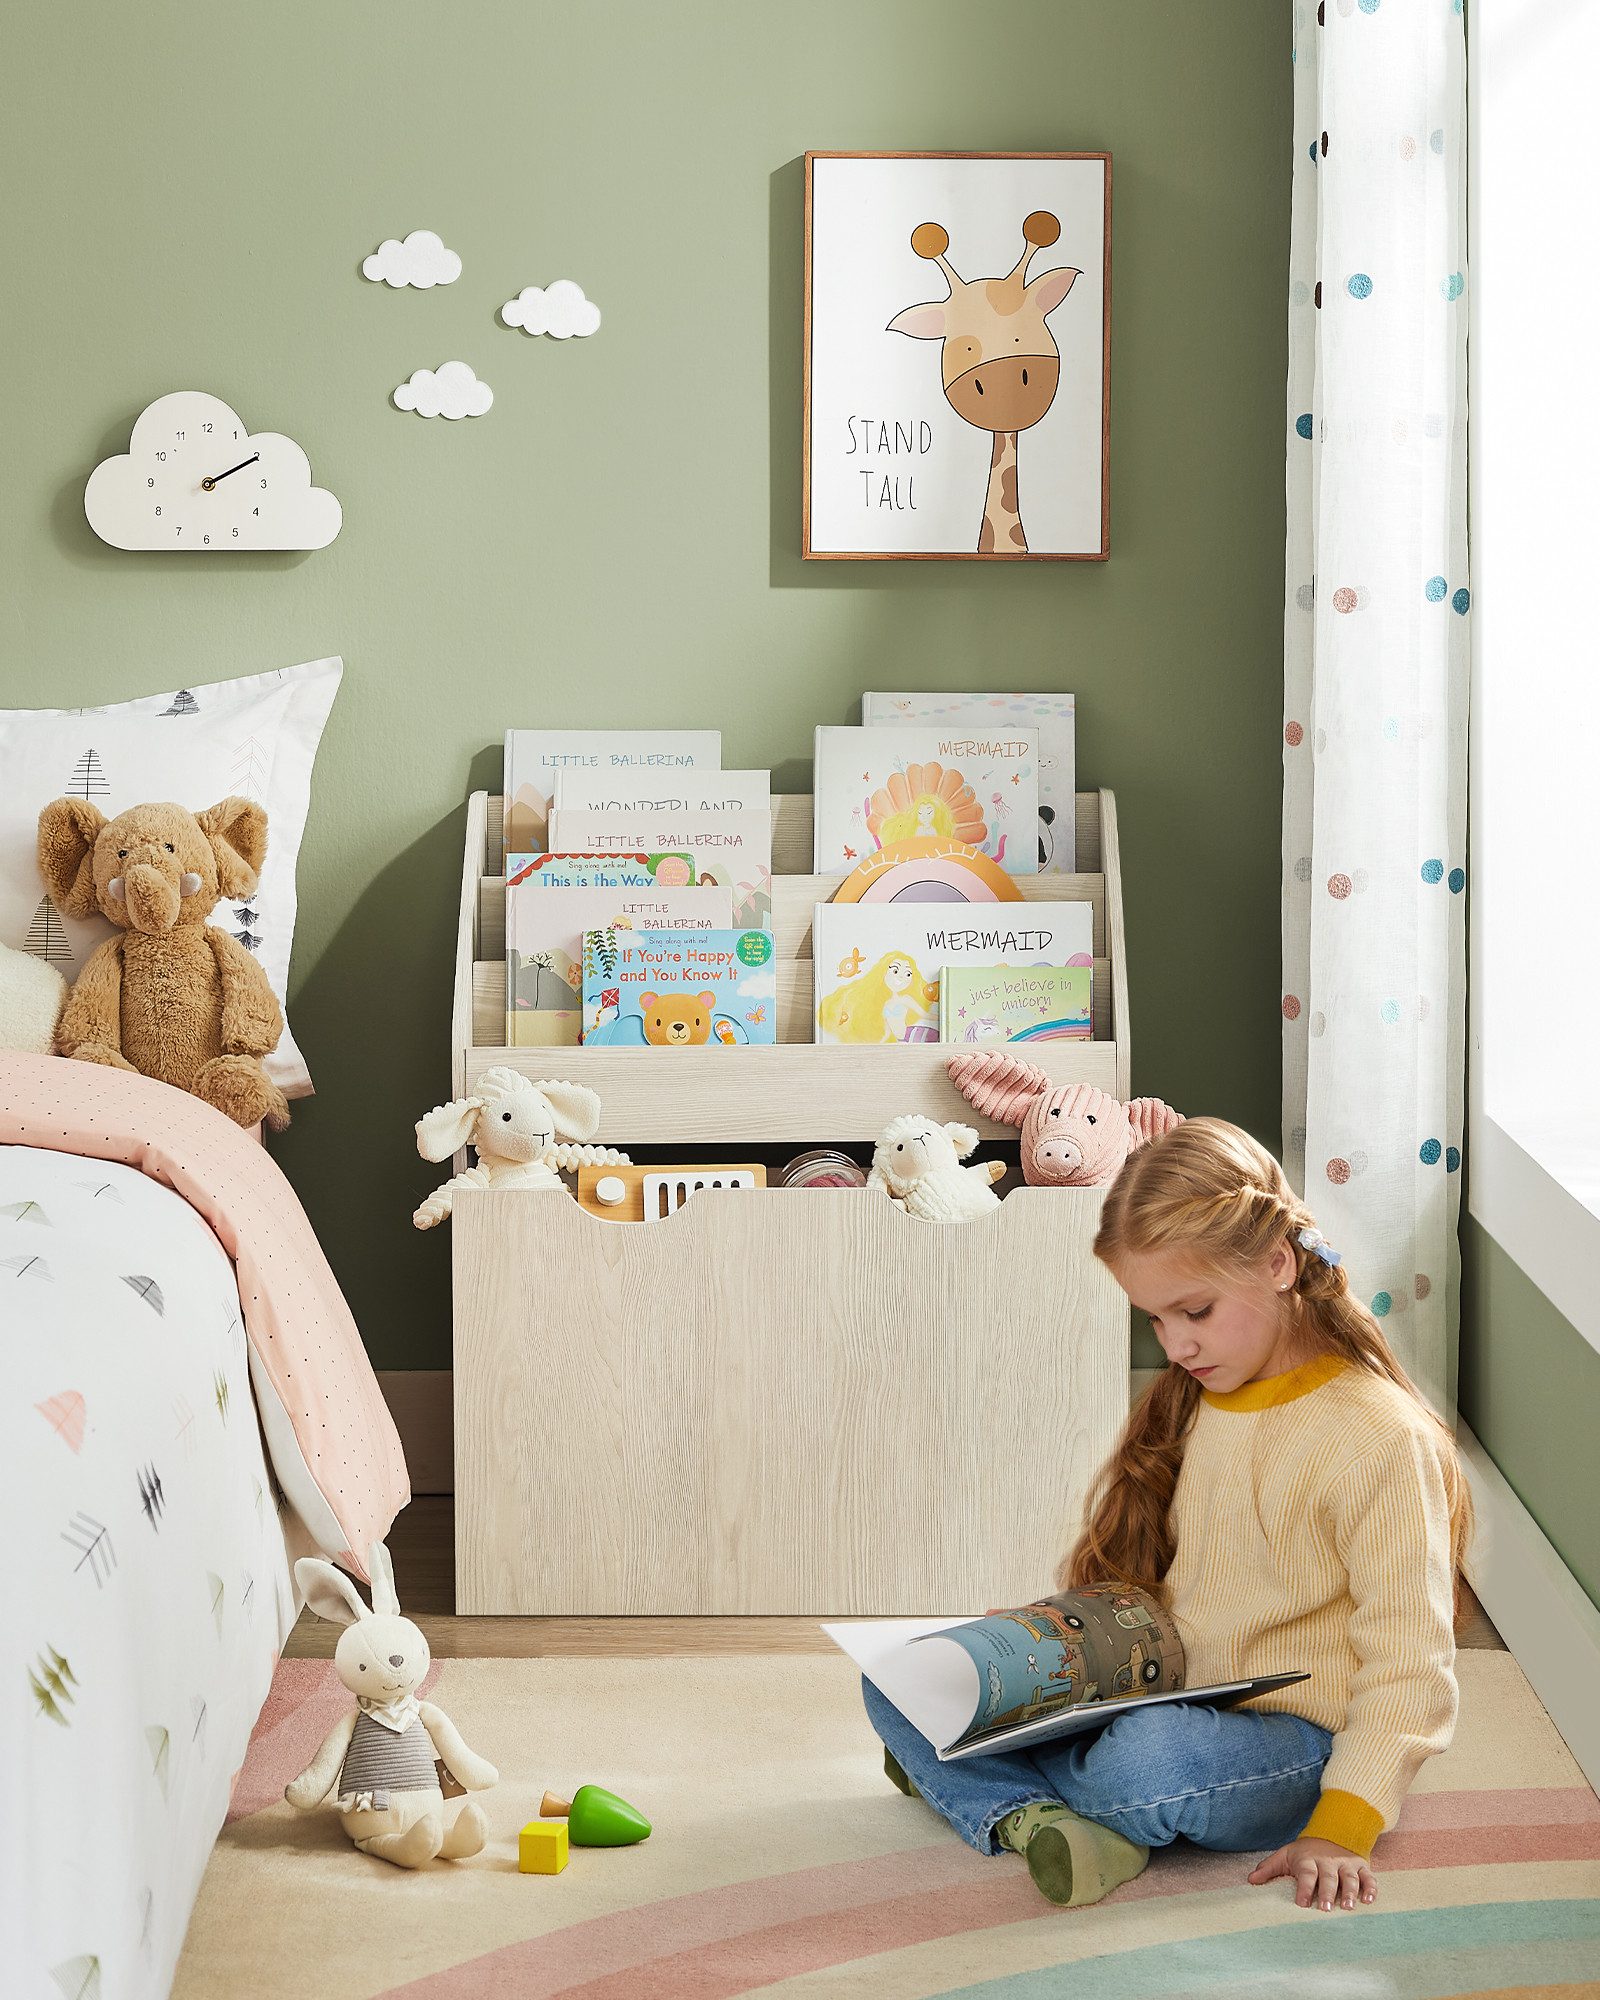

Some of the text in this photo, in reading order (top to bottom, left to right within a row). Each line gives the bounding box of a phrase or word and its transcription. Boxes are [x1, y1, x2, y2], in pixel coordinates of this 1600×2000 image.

[202, 423, 213, 433] 12
[176, 432, 186, 440] 11
[233, 431, 238, 440] 1
[846, 415, 932, 454] STAND
[155, 451, 167, 461] 10
[147, 478, 154, 488] 9
[261, 479, 268, 489] 3
[859, 470, 917, 510] TALL
[155, 506, 162, 516] 8
[252, 507, 260, 516] 4
[175, 527, 182, 536] 7
[232, 528, 239, 537] 5
[203, 535, 210, 544] 6
[938, 740, 1029, 758] MERMAID
[541, 754, 694, 767] LITTLE BALLERINA
[587, 834, 743, 848] LITTLE BALLERINA
[569, 861, 583, 871] Sing
[584, 861, 600, 871] along
[540, 873, 571, 886] This
[577, 875, 588, 886] is
[594, 873, 618, 886] the
[621, 874, 654, 886] Way
[622, 903, 713, 929] LITTLE BALLERINA
[649, 936, 663, 947] Sing
[665, 937, 681, 947] along
[927, 930, 1053, 953] MERMAID
[622, 948, 735, 966] If You're Happy
[619, 967, 738, 982] and You Know It
[969, 977, 1072, 1006] just believe in
[1001, 995, 1052, 1011] unicorn
